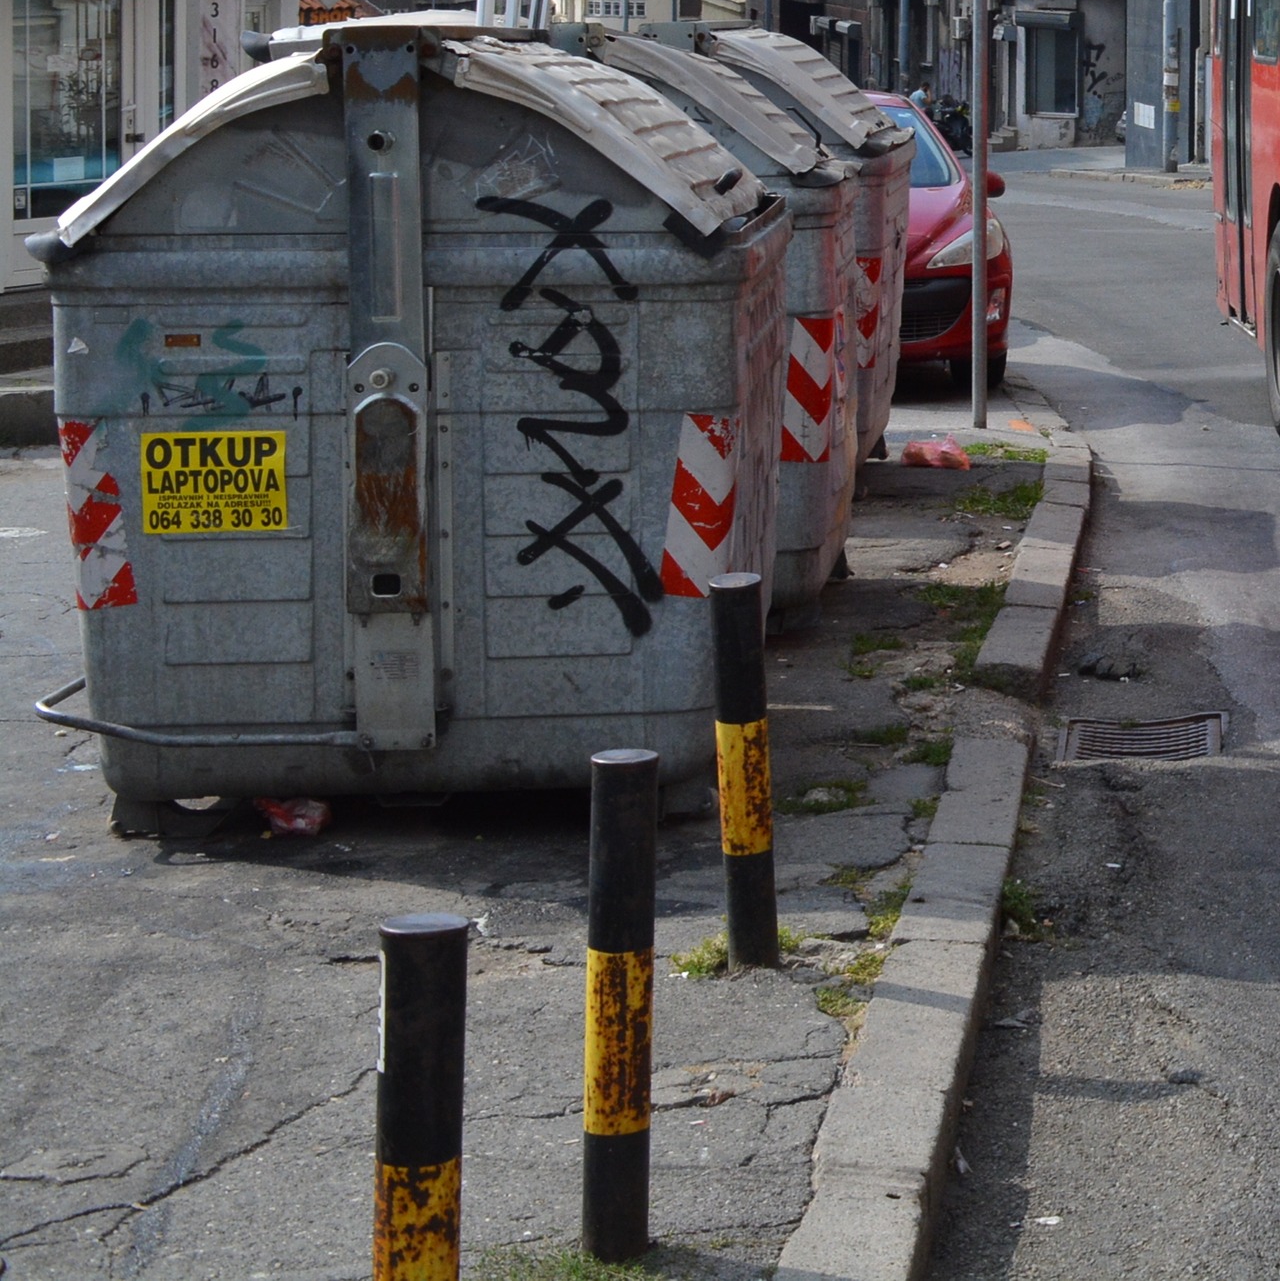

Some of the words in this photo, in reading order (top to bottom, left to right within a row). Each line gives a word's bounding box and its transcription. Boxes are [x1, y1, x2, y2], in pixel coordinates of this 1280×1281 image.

[146, 437, 277, 469] OTKUP
[147, 469, 280, 494] LAPTOPOVA
[157, 501, 203, 509] DOLAZAK
[207, 500, 221, 508] NA
[159, 494, 204, 502] ISPRAVNIM
[213, 493, 269, 501] NEISPRAVNIM
[150, 510, 182, 530] 064
[190, 509, 223, 529] 338
[231, 508, 253, 528] 30
[261, 507, 283, 527] 30
